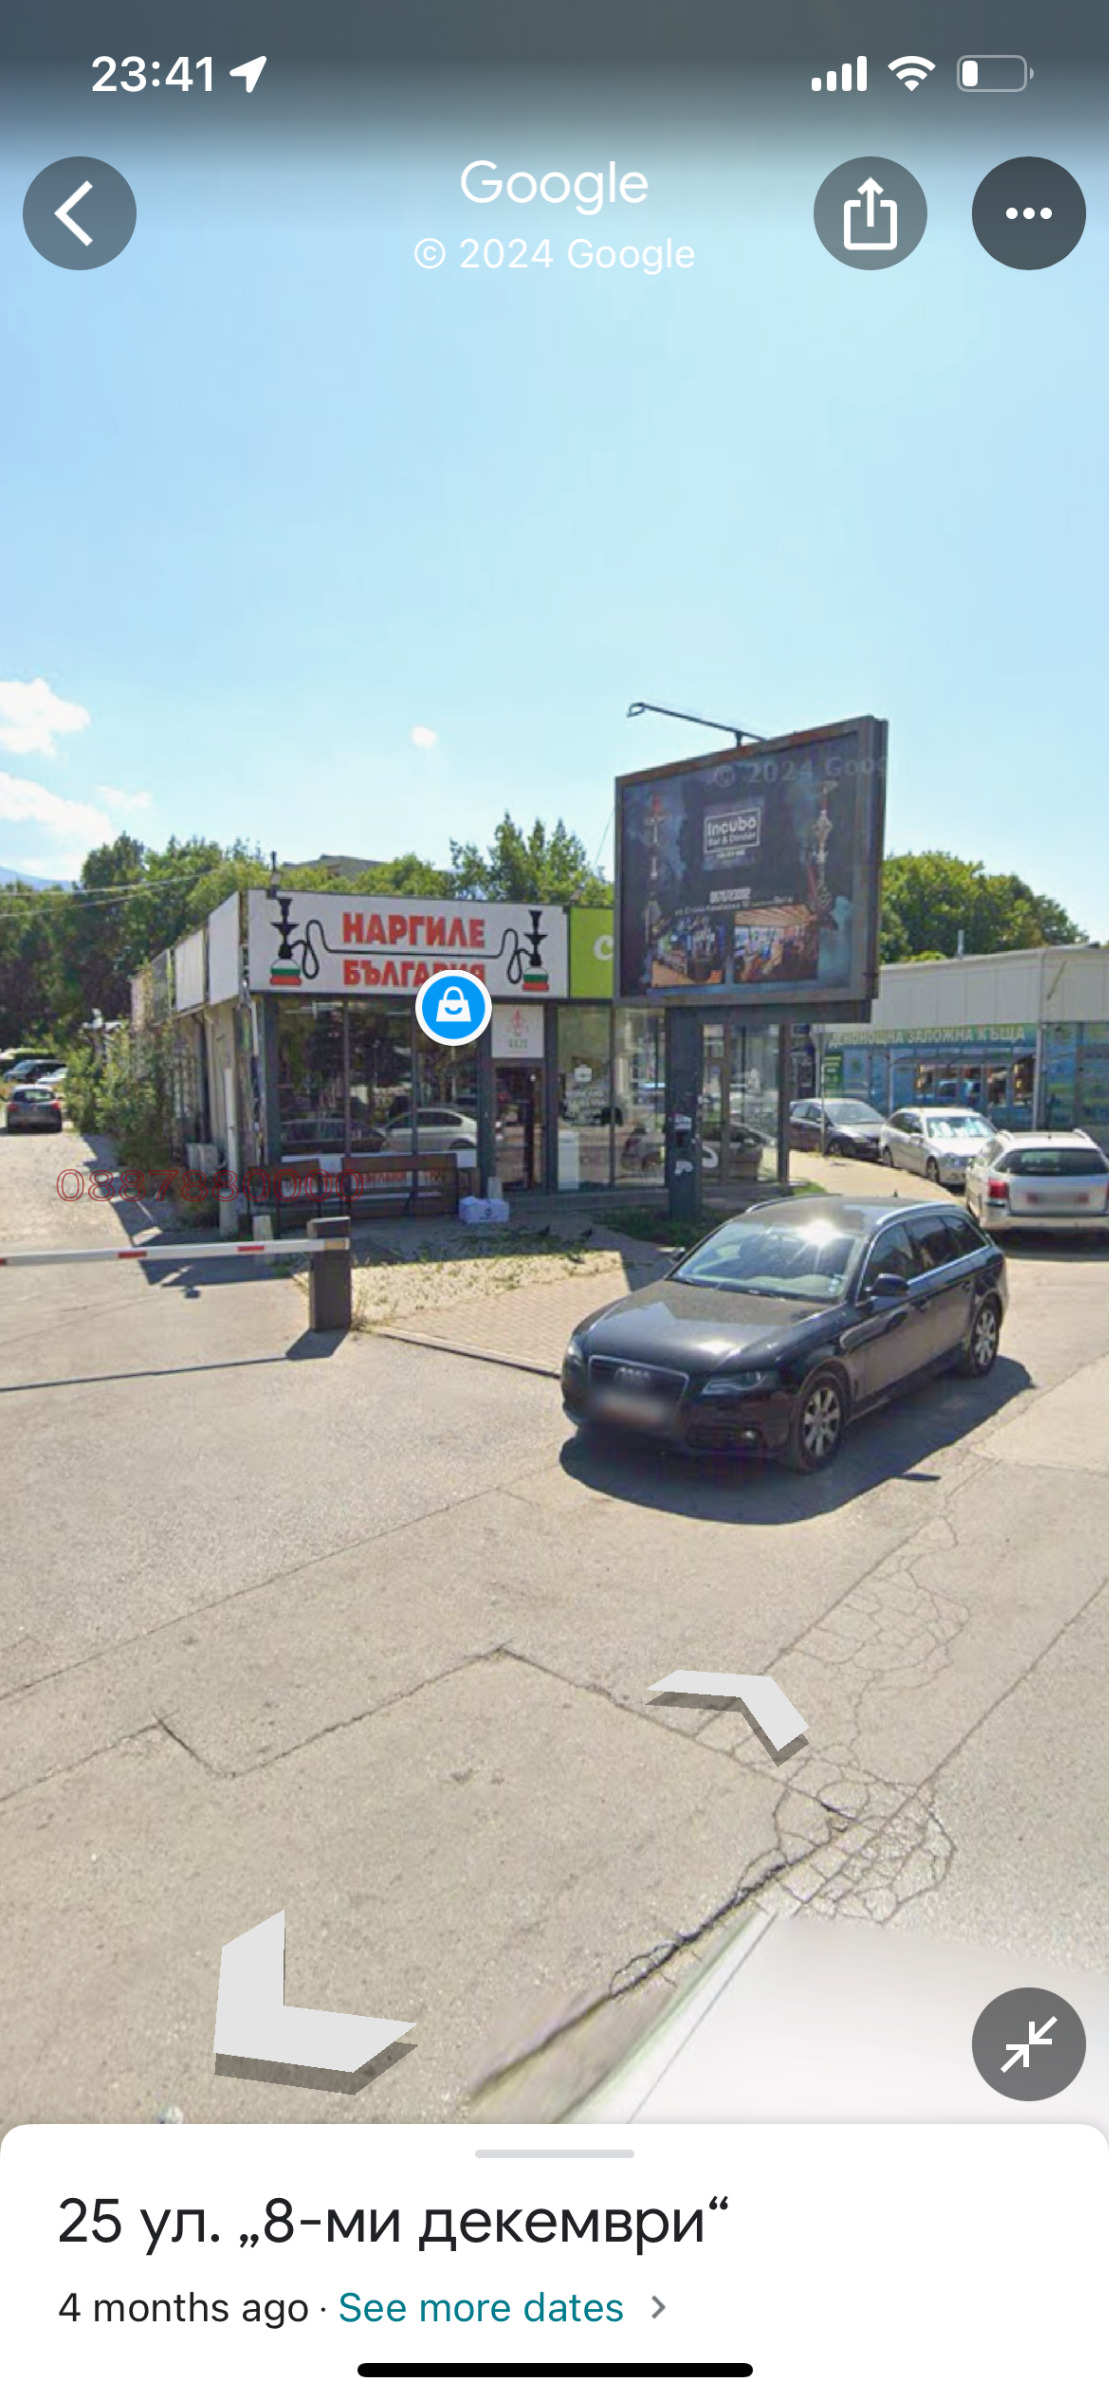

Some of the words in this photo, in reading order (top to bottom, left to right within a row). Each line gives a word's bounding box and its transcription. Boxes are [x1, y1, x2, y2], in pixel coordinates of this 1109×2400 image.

[707, 816, 757, 837] Incubo
[342, 912, 486, 948] НАРГИЛЕ
[343, 959, 486, 988] БЪЛГАЯ
[908, 1027, 973, 1044] ЗАЛОЖНА
